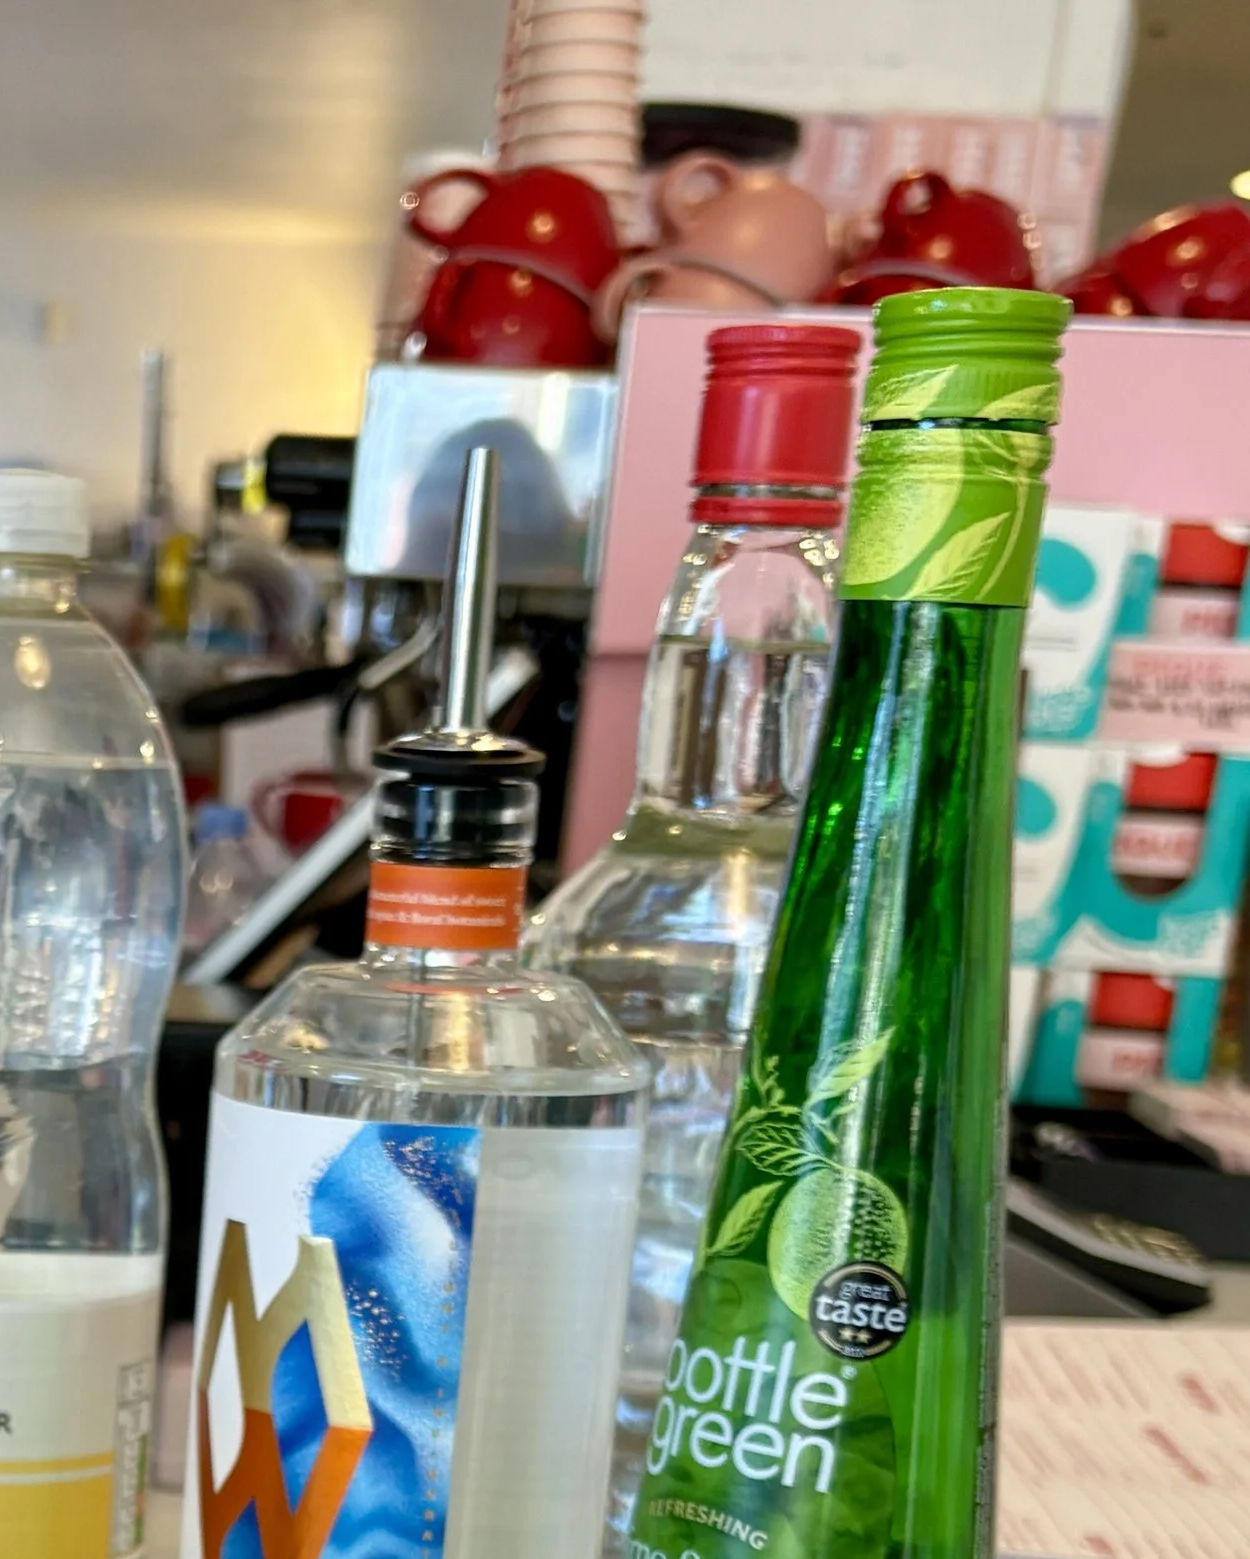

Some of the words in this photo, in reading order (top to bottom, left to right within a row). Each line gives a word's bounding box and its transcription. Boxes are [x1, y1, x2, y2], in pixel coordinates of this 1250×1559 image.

[814, 1294, 908, 1334] taste
[838, 1281, 891, 1301] great
[646, 1395, 836, 1494] green
[649, 1498, 769, 1551] REFRESHING
